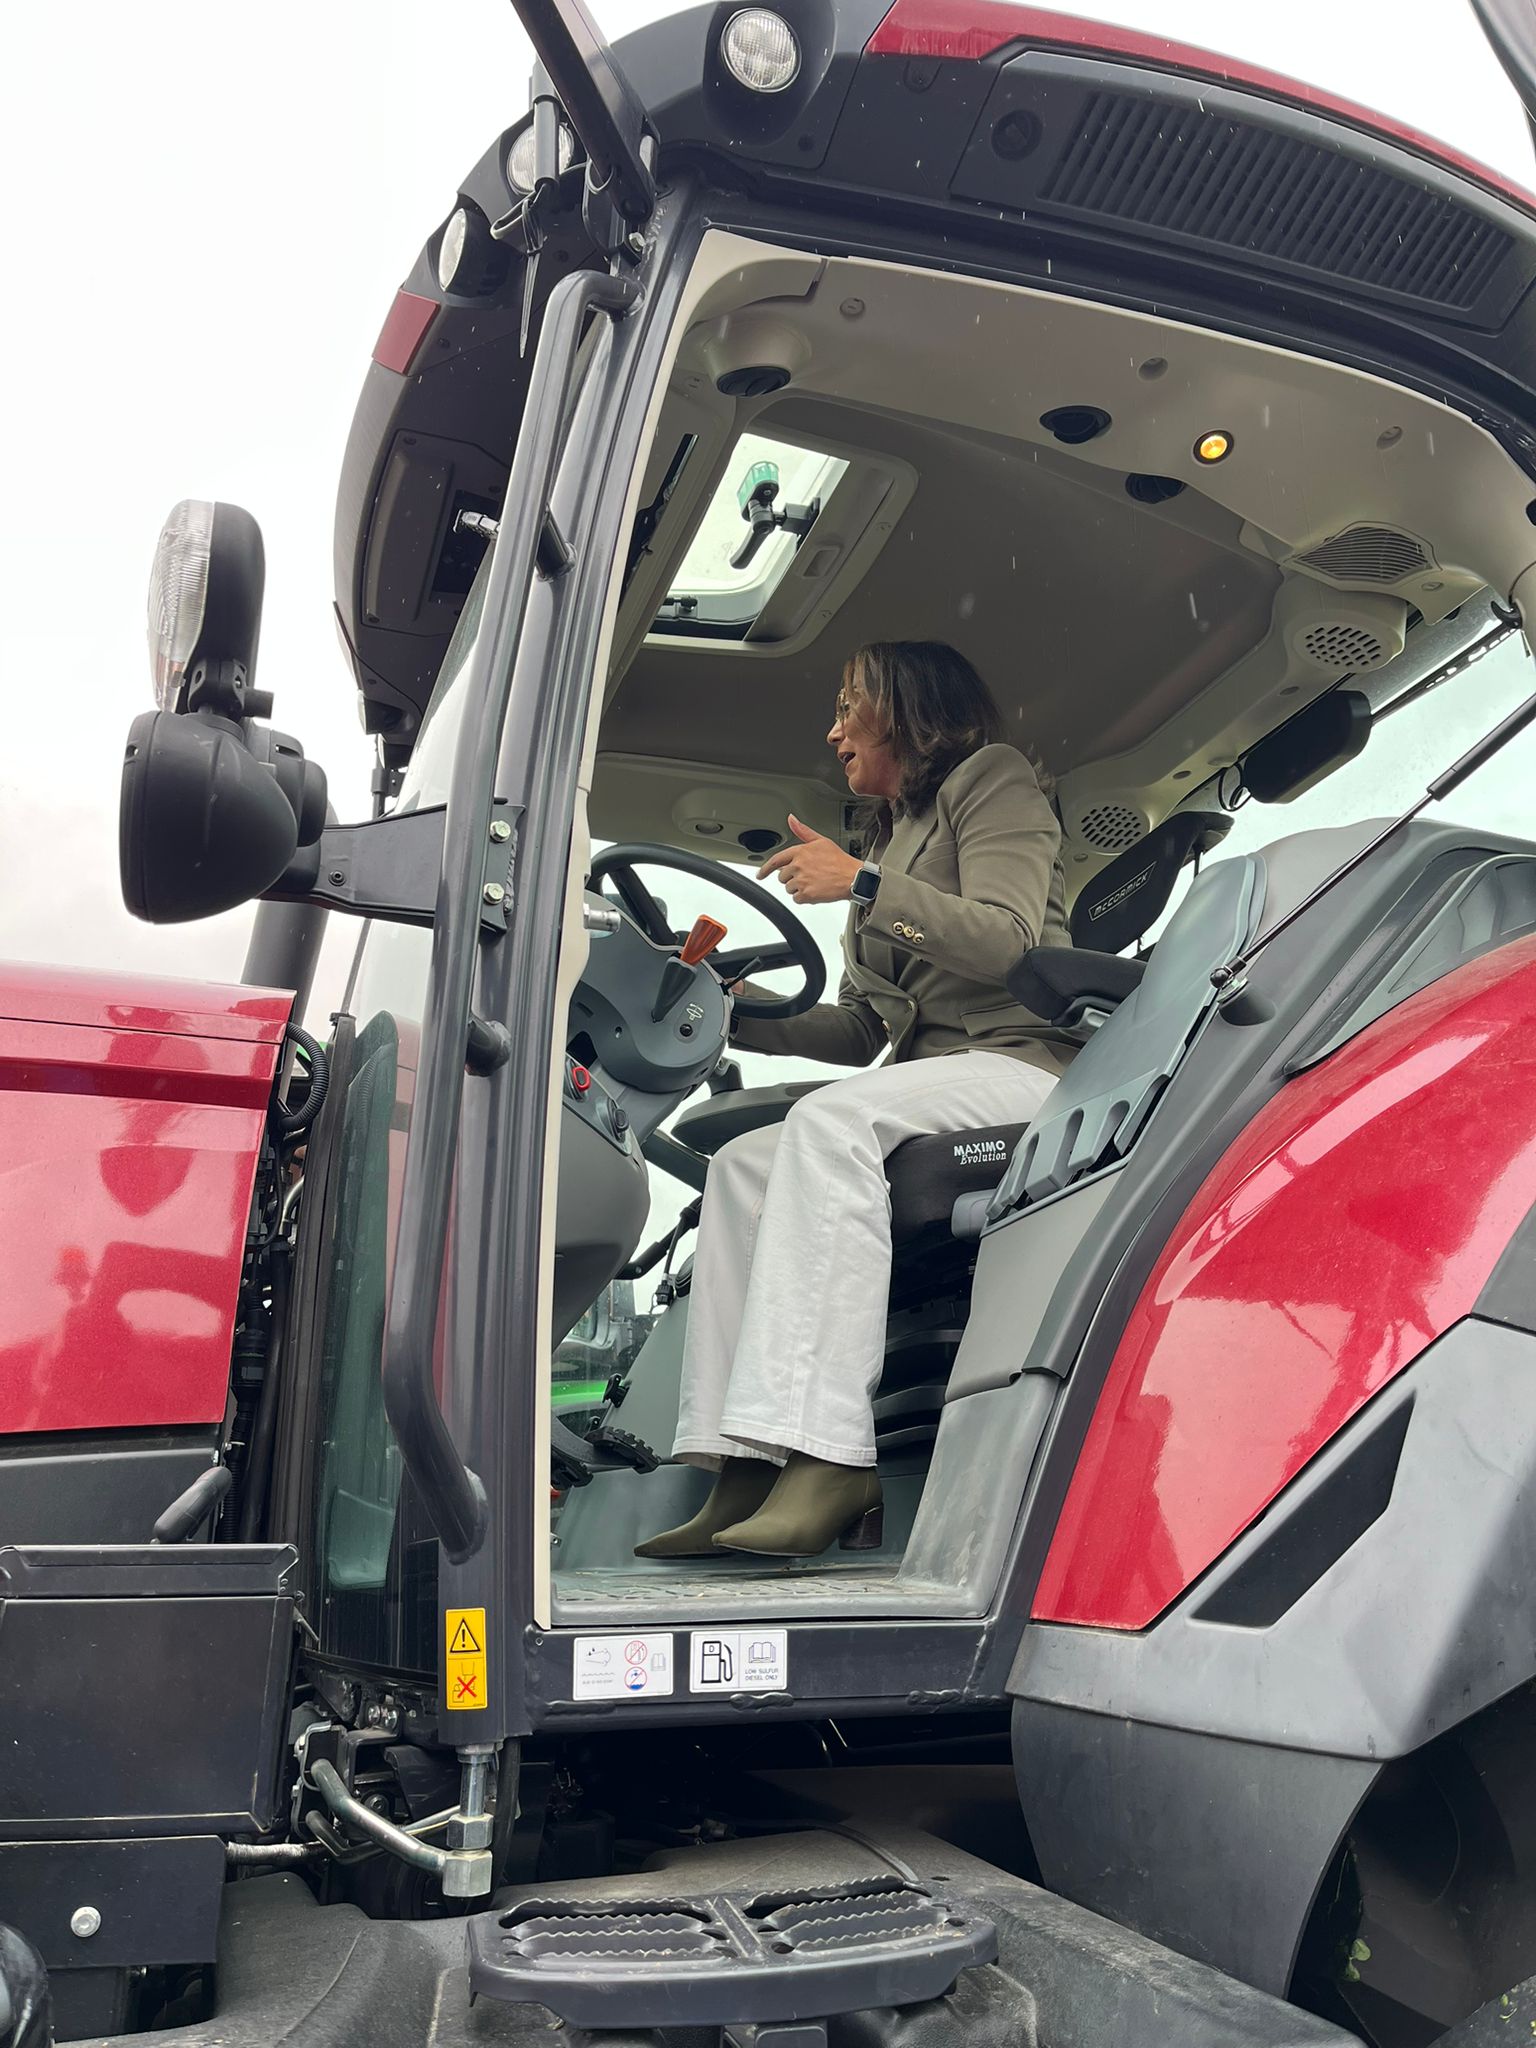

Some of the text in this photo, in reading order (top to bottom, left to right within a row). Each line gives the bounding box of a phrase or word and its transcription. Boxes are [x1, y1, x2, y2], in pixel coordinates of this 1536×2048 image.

[954, 1140, 1005, 1156] MAXIMO
[960, 1152, 1006, 1165] Evolution
[709, 1645, 715, 1653] D
